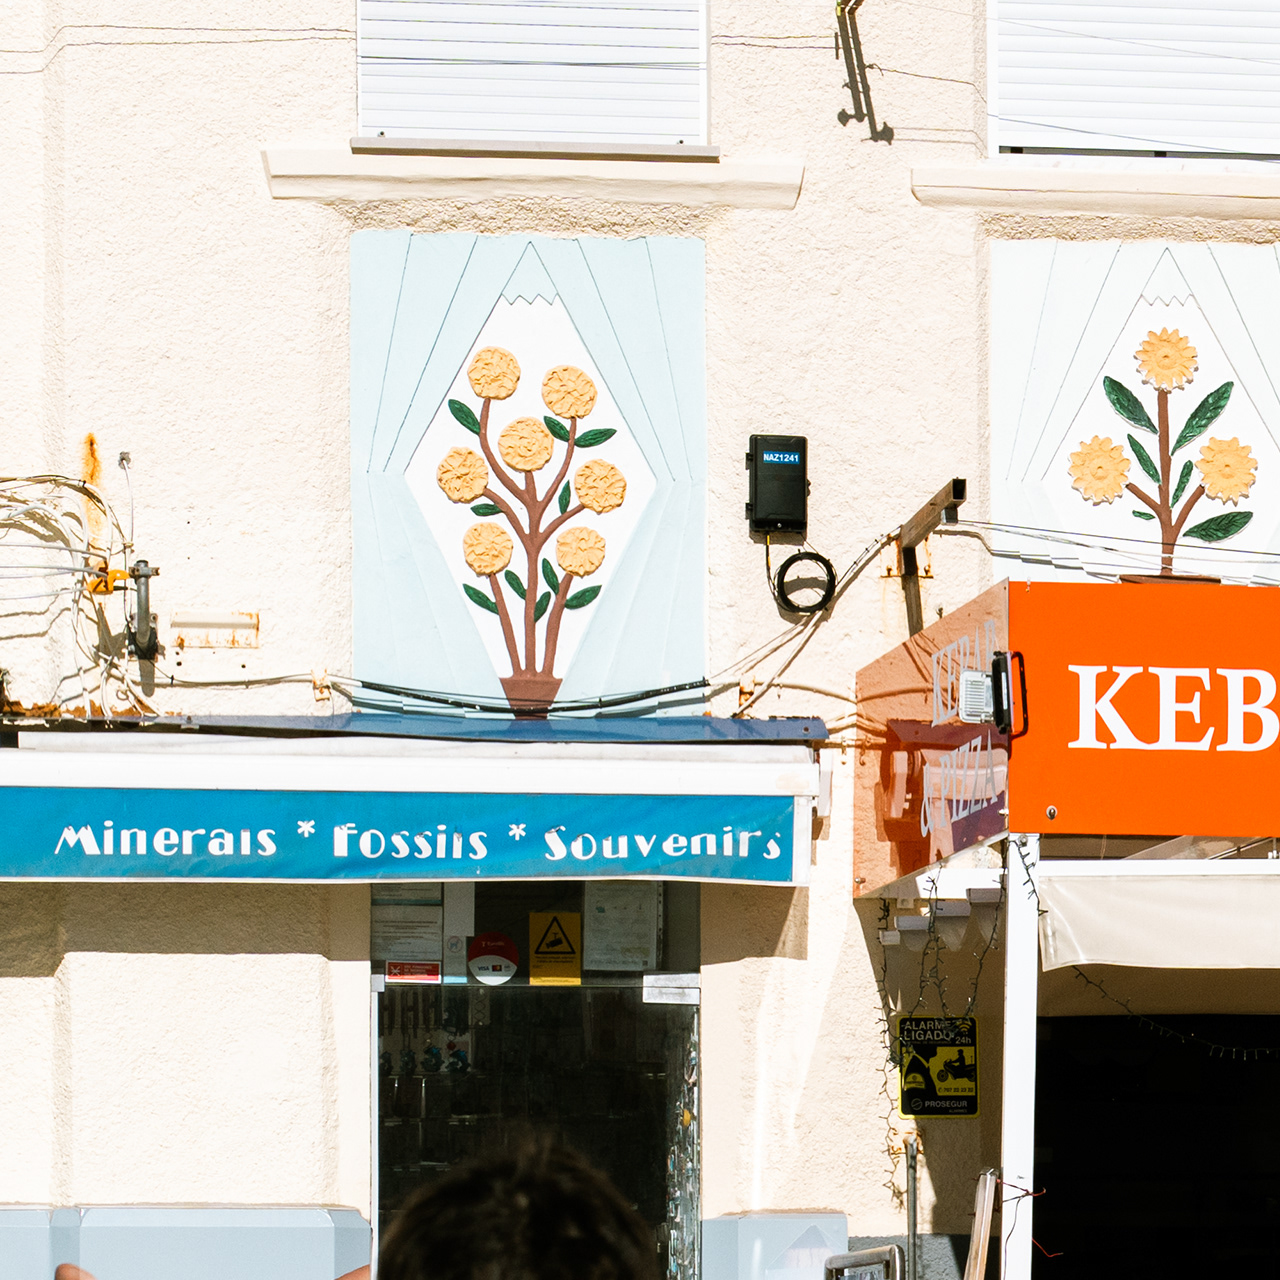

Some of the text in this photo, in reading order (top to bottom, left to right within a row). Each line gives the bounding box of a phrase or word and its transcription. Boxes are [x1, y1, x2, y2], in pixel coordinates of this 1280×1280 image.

[763, 453, 799, 463] NAZ1241
[939, 728, 999, 828] PIZZA
[544, 825, 781, 861] Souvenirs
[904, 1020, 952, 1030] ALARME
[904, 1030, 952, 1041] LIGADO
[955, 1036, 972, 1044] 24h
[924, 1100, 968, 1108] PROSEGUR
